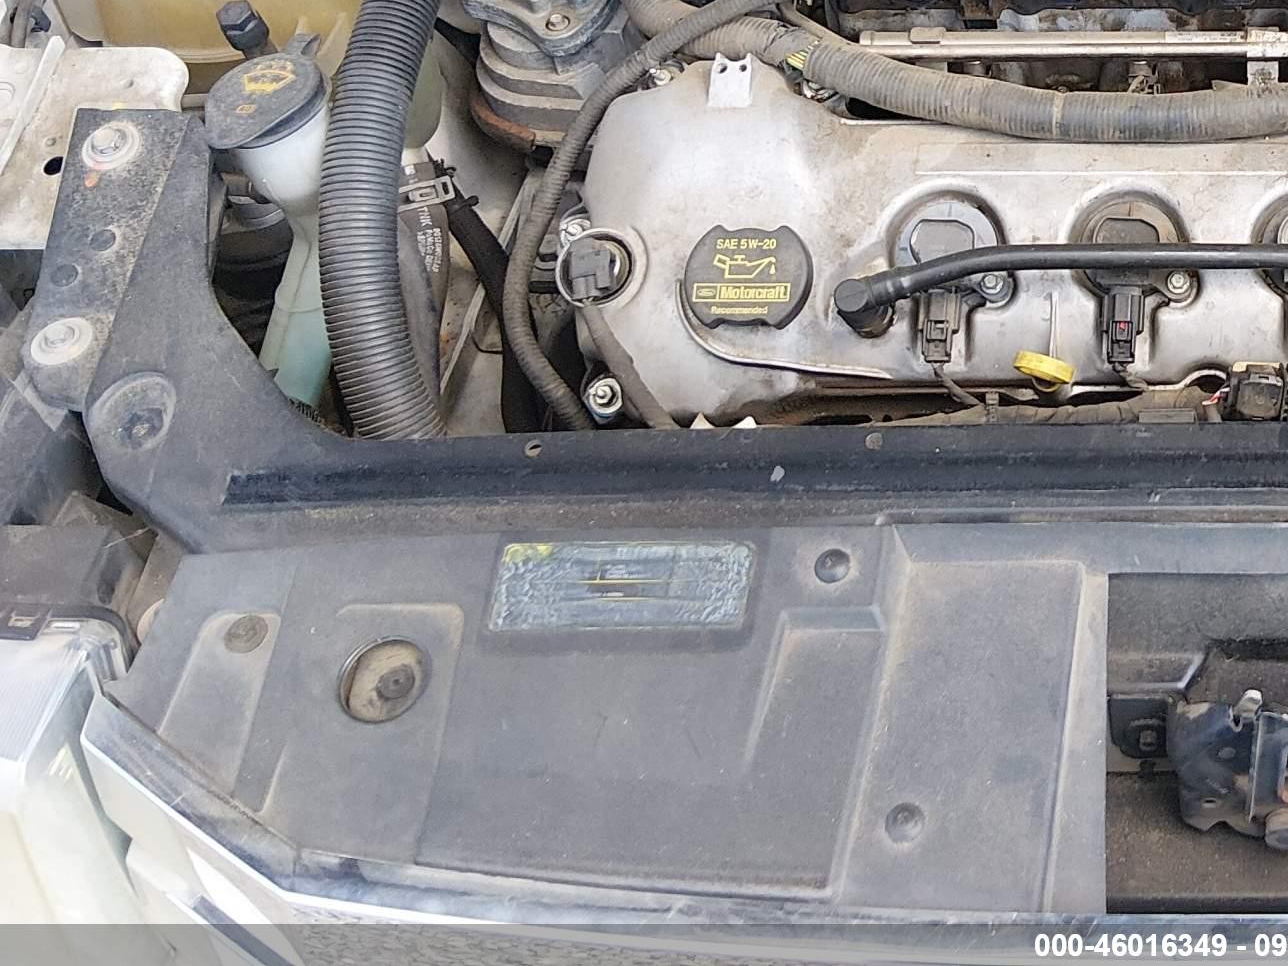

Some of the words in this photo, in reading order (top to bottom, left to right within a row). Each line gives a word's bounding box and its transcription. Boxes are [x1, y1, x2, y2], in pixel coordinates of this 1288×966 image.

[716, 238, 738, 250] SAE
[740, 238, 777, 250] 5W-20
[719, 285, 787, 300] Motorcraft
[711, 305, 768, 315] Recommended
